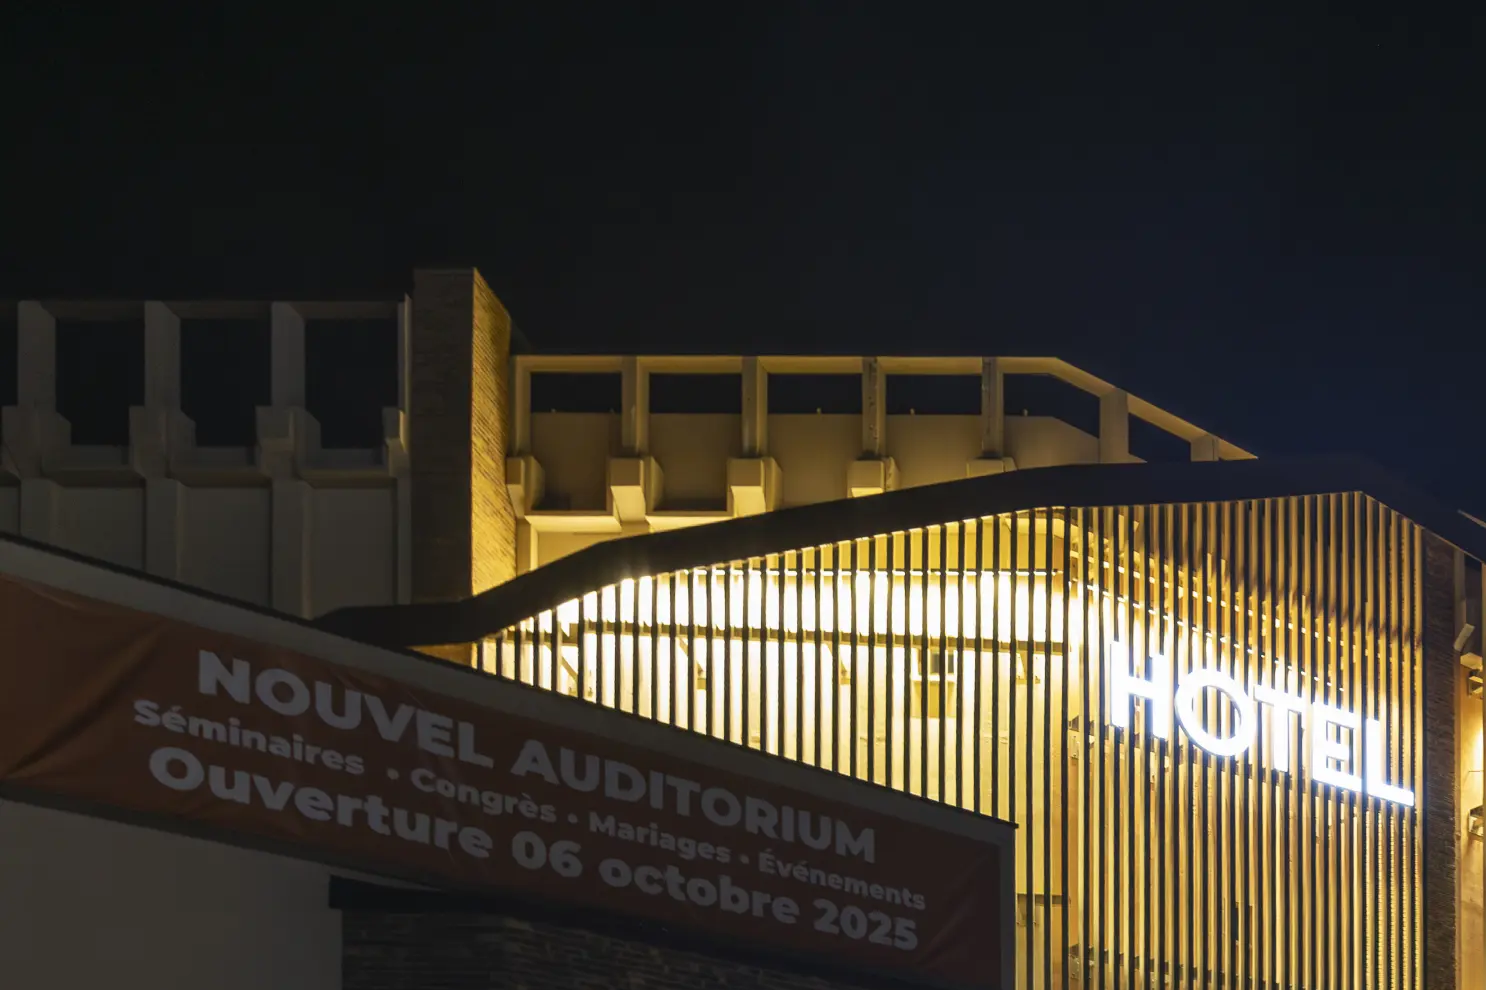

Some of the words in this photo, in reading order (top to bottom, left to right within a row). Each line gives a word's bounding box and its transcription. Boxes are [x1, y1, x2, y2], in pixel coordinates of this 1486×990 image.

[133, 699, 365, 776] Séminaires
[410, 767, 557, 824] Congrès
[589, 811, 731, 864] Mariages
[758, 848, 926, 911] Événements
[197, 650, 495, 769] NOUVEL
[510, 738, 876, 864] AUDITORIUM
[1110, 640, 1414, 806] HOTEL
[149, 746, 493, 859] Ouverture
[511, 830, 584, 877] 06
[599, 858, 799, 924] octobre
[812, 898, 918, 952] 2025
